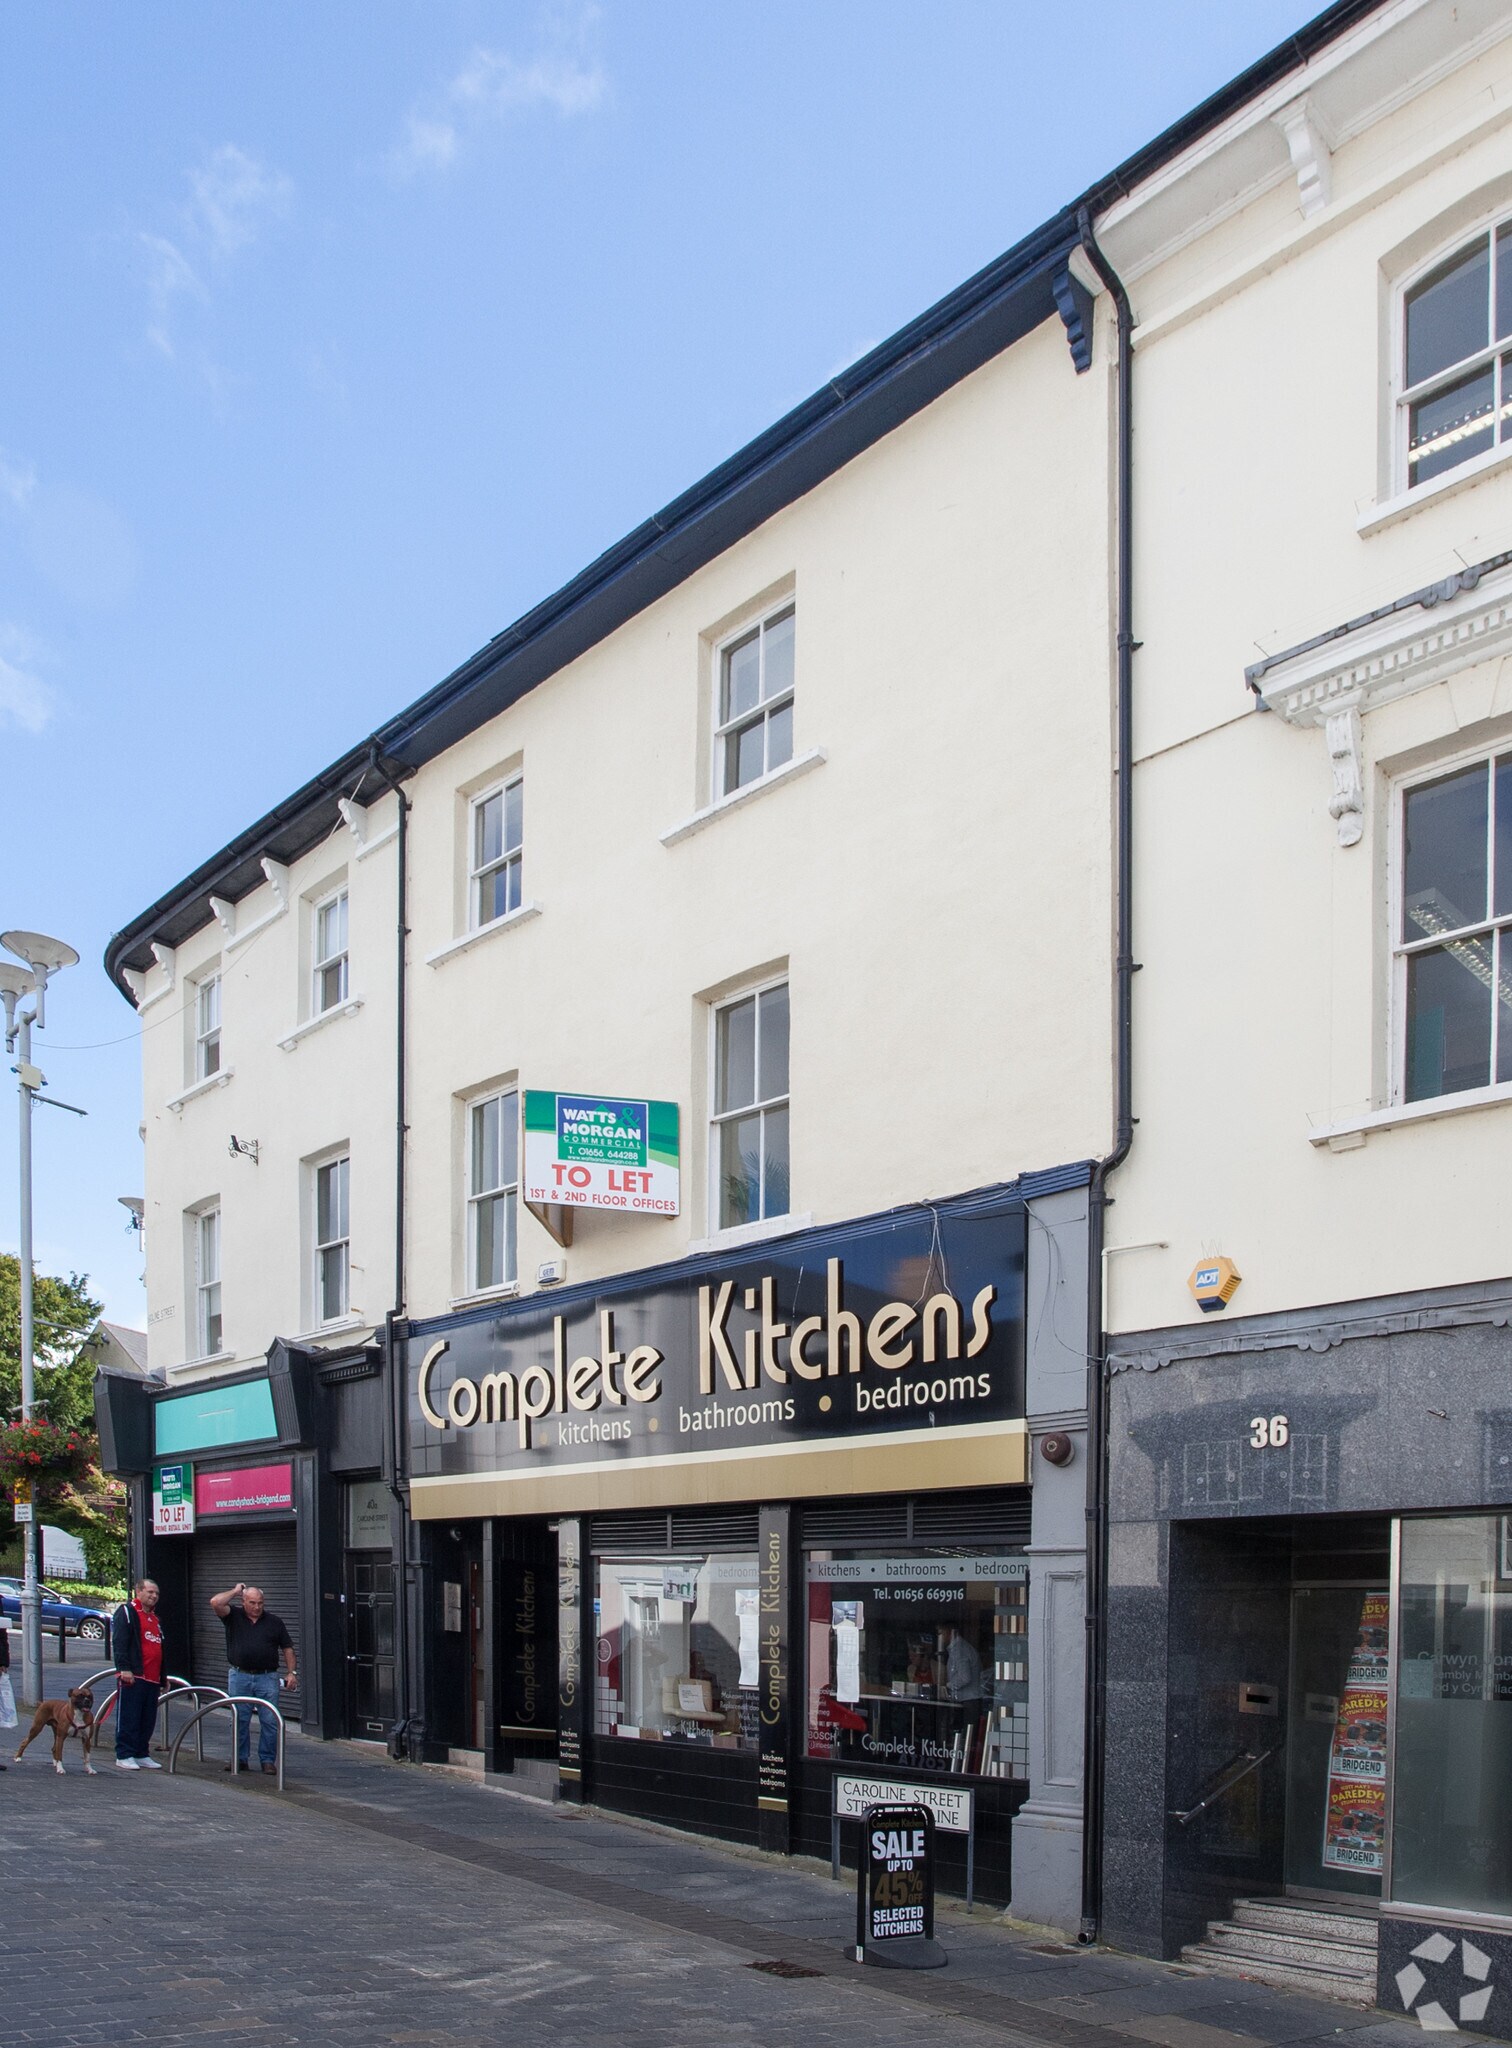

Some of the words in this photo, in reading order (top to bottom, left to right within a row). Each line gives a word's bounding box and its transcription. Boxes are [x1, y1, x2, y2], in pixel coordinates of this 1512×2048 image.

[562, 1108, 617, 1124] WATTS
[619, 1107, 640, 1128] &
[563, 1122, 641, 1140] MORGAN
[563, 1135, 641, 1149] COMMERCIAL
[578, 1147, 604, 1157] 01656
[607, 1150, 638, 1160] 644288
[551, 1164, 591, 1187] TO
[608, 1169, 653, 1193] LET
[530, 1188, 545, 1198] 1ST
[551, 1190, 558, 1199] &
[565, 1191, 586, 1202] 2ND
[592, 1194, 626, 1206] FLOOR
[633, 1198, 675, 1211] OFFICES
[1195, 1271, 1219, 1285] ADT
[418, 1310, 665, 1449] Complete
[699, 1257, 997, 1395] Kitchens
[558, 1418, 631, 1445] kitchens
[679, 1398, 795, 1432] bathrooms
[856, 1373, 991, 1412] bedrooms
[1250, 1416, 1288, 1449] 36
[160, 1508, 171, 1522] TO
[174, 1507, 185, 1521] LET
[761, 1532, 781, 1612] Kitchens
[818, 1564, 861, 1576] kitchens
[886, 1563, 947, 1576] bathrooms
[873, 1588, 891, 1600] Tel.
[894, 1589, 924, 1602] 01656
[926, 1588, 964, 1601] 669916
[515, 1643, 540, 1723] Complete
[760, 1624, 786, 1725] Complete
[808, 1730, 837, 1741] BOSCH
[862, 1733, 916, 1758] Complete
[762, 1752, 784, 1764] kitchens
[1342, 1758, 1382, 1772] BRIDGEND
[759, 1764, 787, 1776] bathrooms
[760, 1776, 786, 1788] bedrooms
[843, 1782, 906, 1801] CAROLINE
[913, 1790, 963, 1808] STREET
[872, 1830, 925, 1860] SALE
[1336, 1848, 1375, 1863] BRIDGEND
[887, 1860, 899, 1872] UP
[900, 1860, 913, 1871] TO
[908, 1894, 923, 1904] OFF
[873, 1906, 924, 1923] SELECTED
[873, 1920, 924, 1937] KITCHENS
